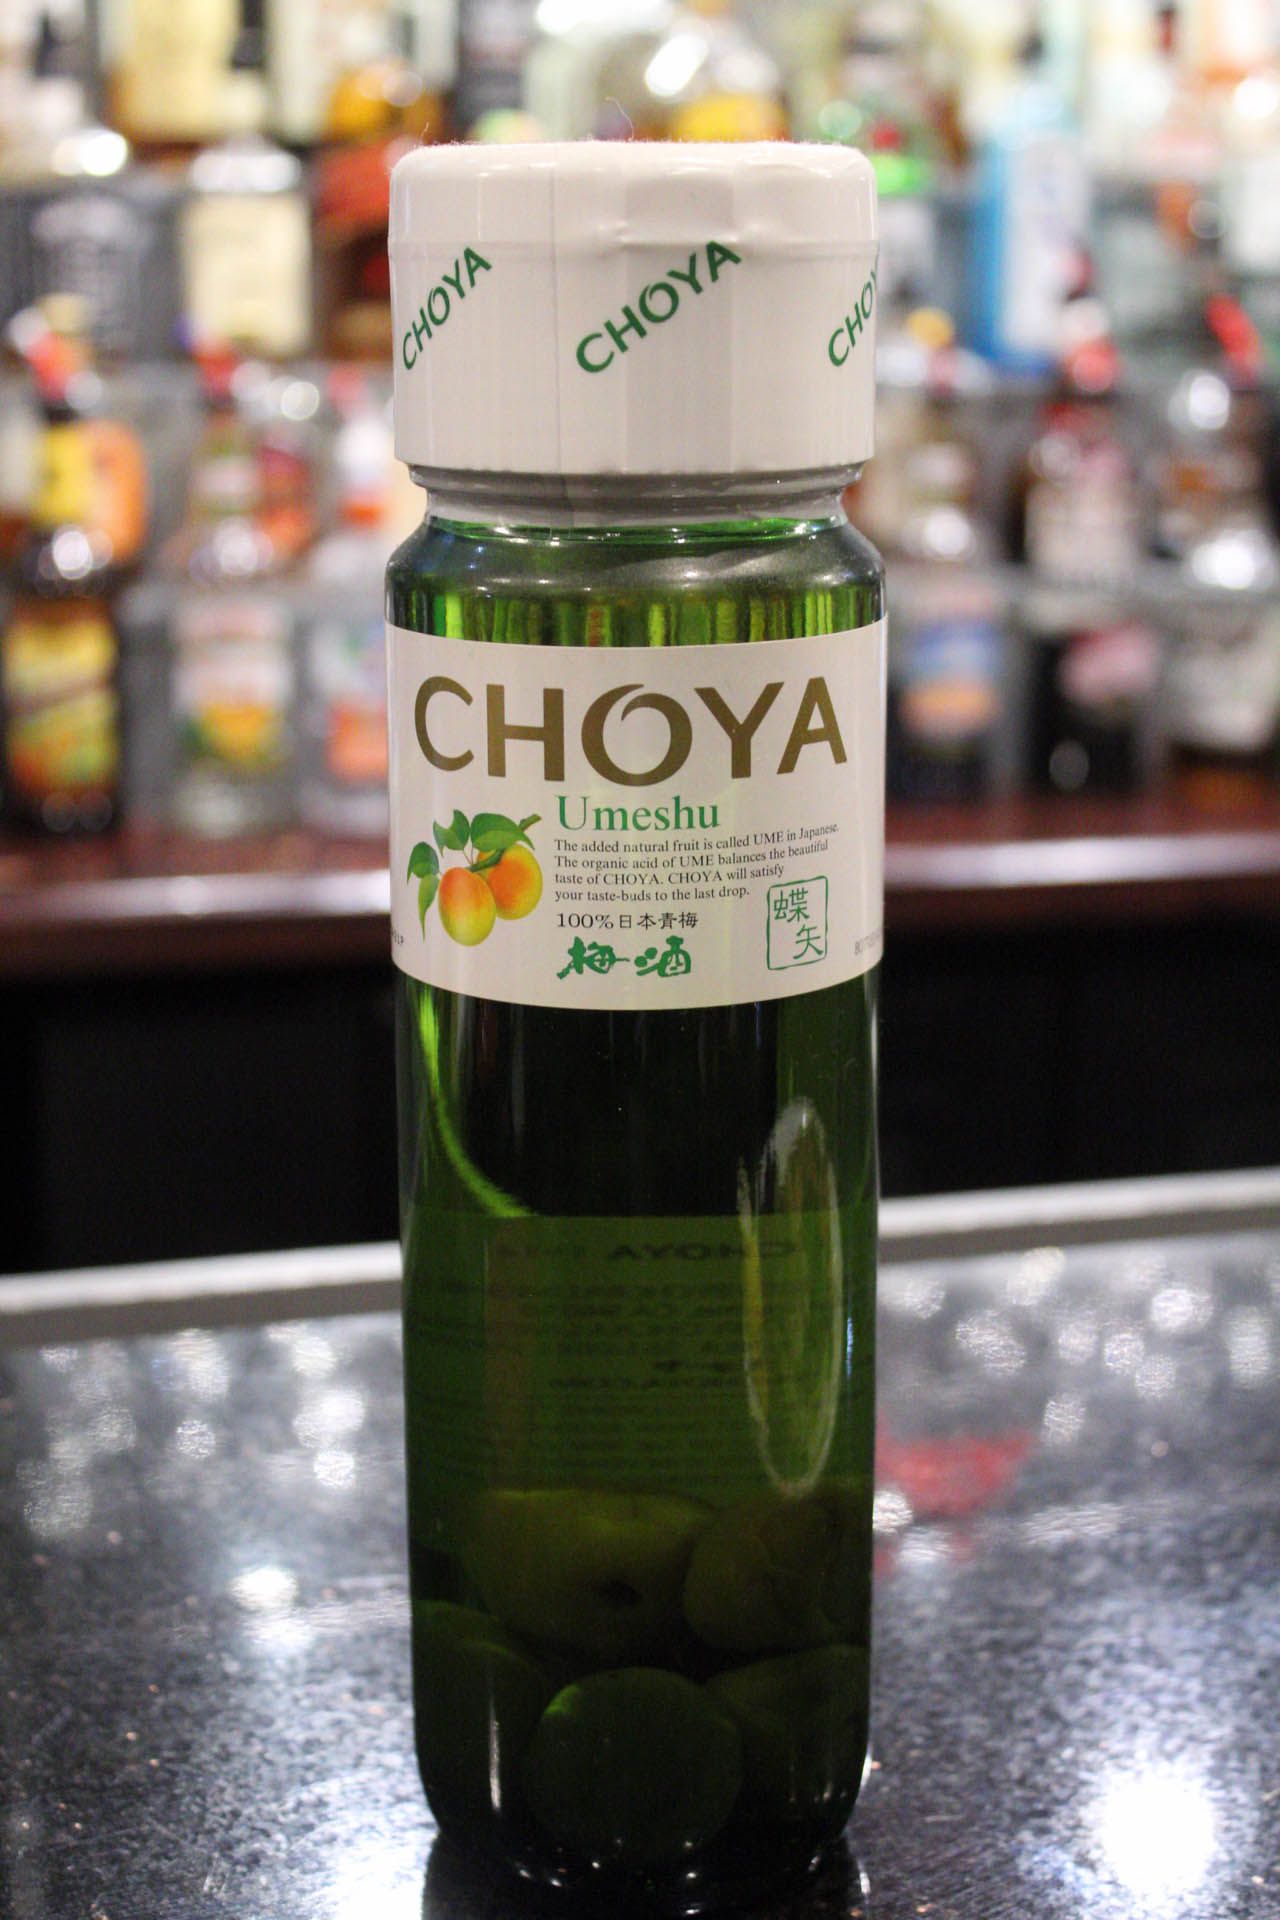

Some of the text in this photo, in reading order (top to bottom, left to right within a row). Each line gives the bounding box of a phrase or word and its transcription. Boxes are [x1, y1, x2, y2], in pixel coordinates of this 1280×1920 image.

[401, 247, 492, 371] CHOYA
[575, 241, 742, 374] CHOYA
[414, 675, 848, 786] CHOYA
[556, 795, 720, 831] Umeshu
[554, 839, 578, 852] The
[581, 840, 619, 853] added
[623, 840, 669, 853] natural
[673, 839, 700, 851] fruit
[703, 838, 713, 850] is
[716, 835, 750, 849] called
[754, 831, 784, 845] UME
[787, 831, 797, 841] in
[554, 839, 829, 872] The organic acid of UME balances the beautiful
[555, 863, 785, 885] taste of CHOYA. CHOYA will satisfy
[555, 885, 750, 902] your taste-buds to the last drop.
